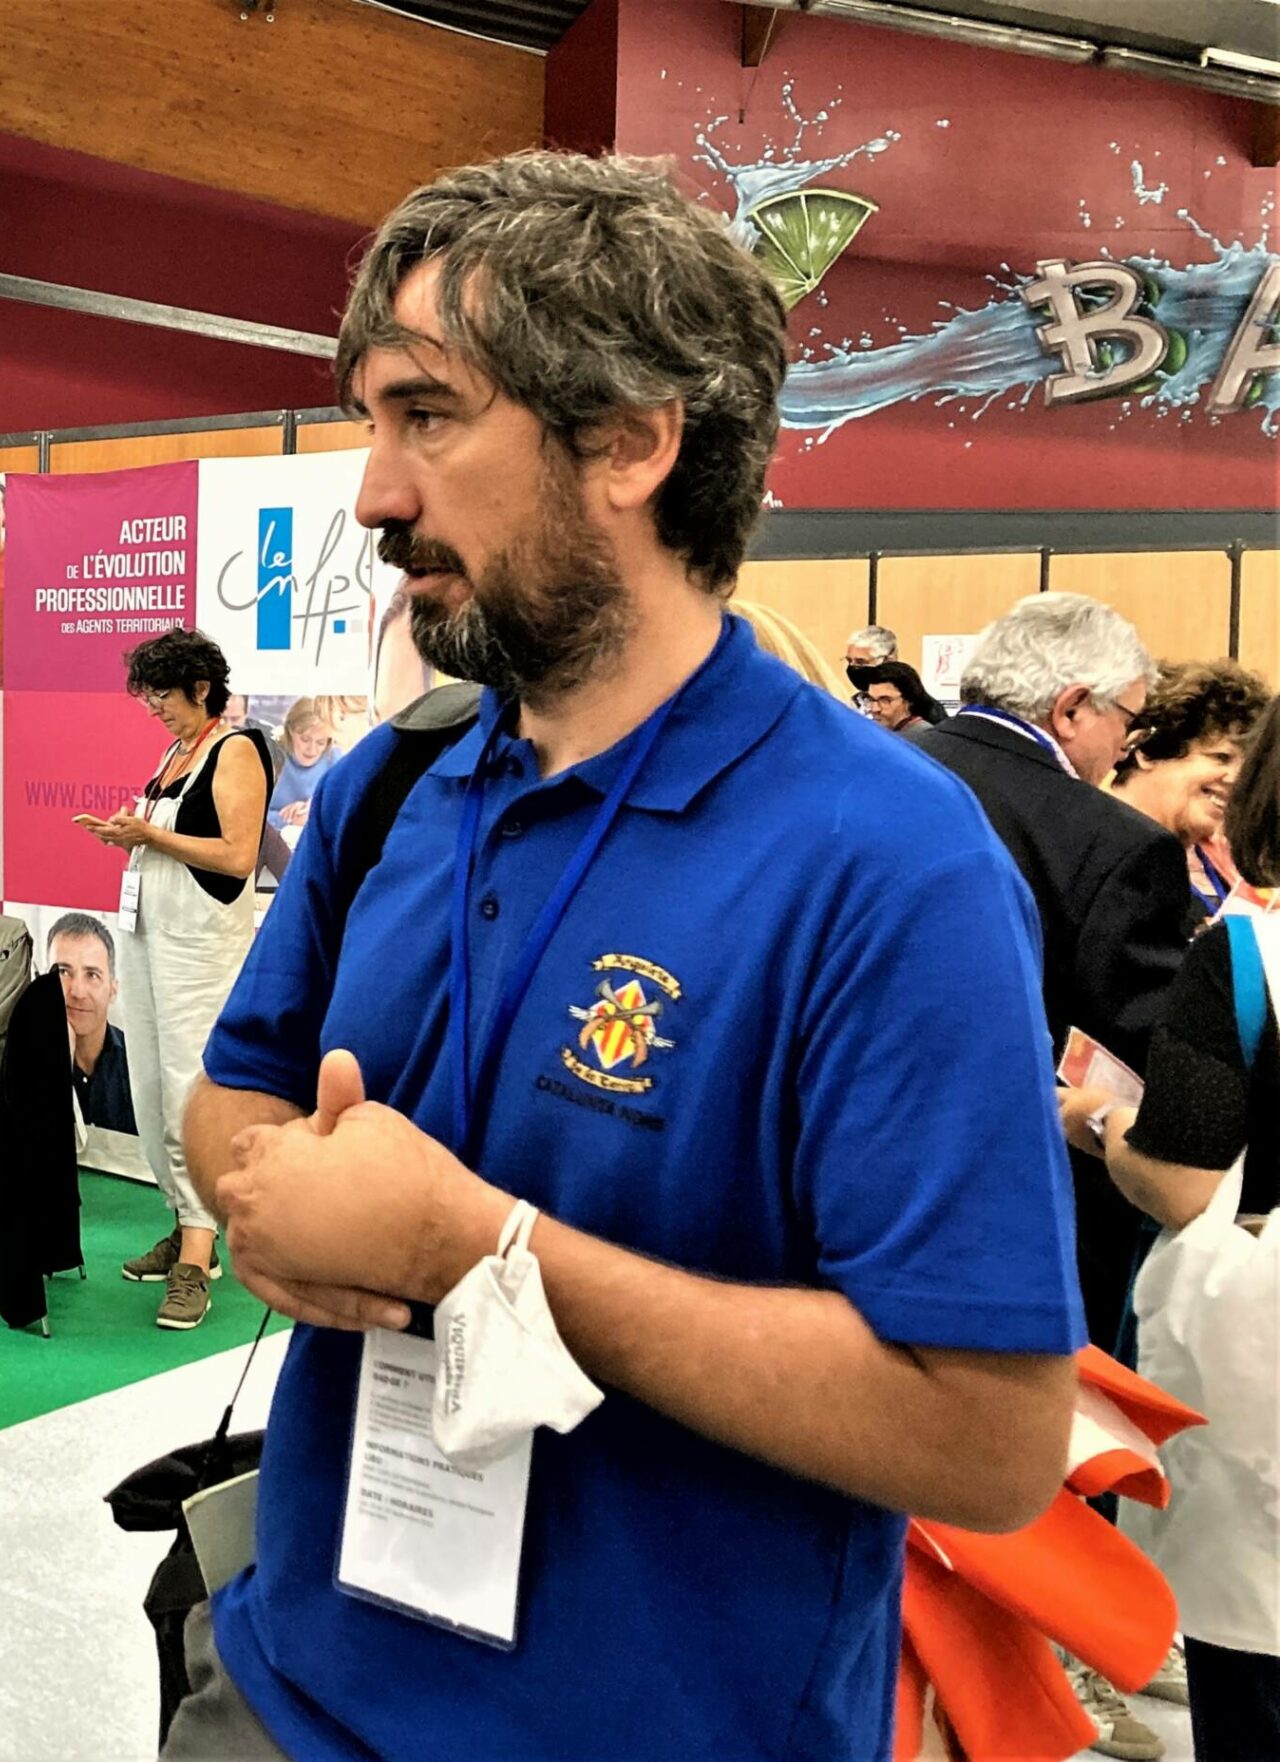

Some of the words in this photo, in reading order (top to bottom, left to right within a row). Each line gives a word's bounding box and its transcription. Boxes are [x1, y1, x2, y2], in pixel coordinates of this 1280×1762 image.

[119, 515, 187, 545] ACTEUR
[66, 564, 80, 579] DE
[83, 549, 186, 579] L'ÉVOLUTION
[35, 584, 186, 612] PROFESSIONNELLE
[61, 622, 75, 634] DES
[76, 618, 113, 633] AGENTS
